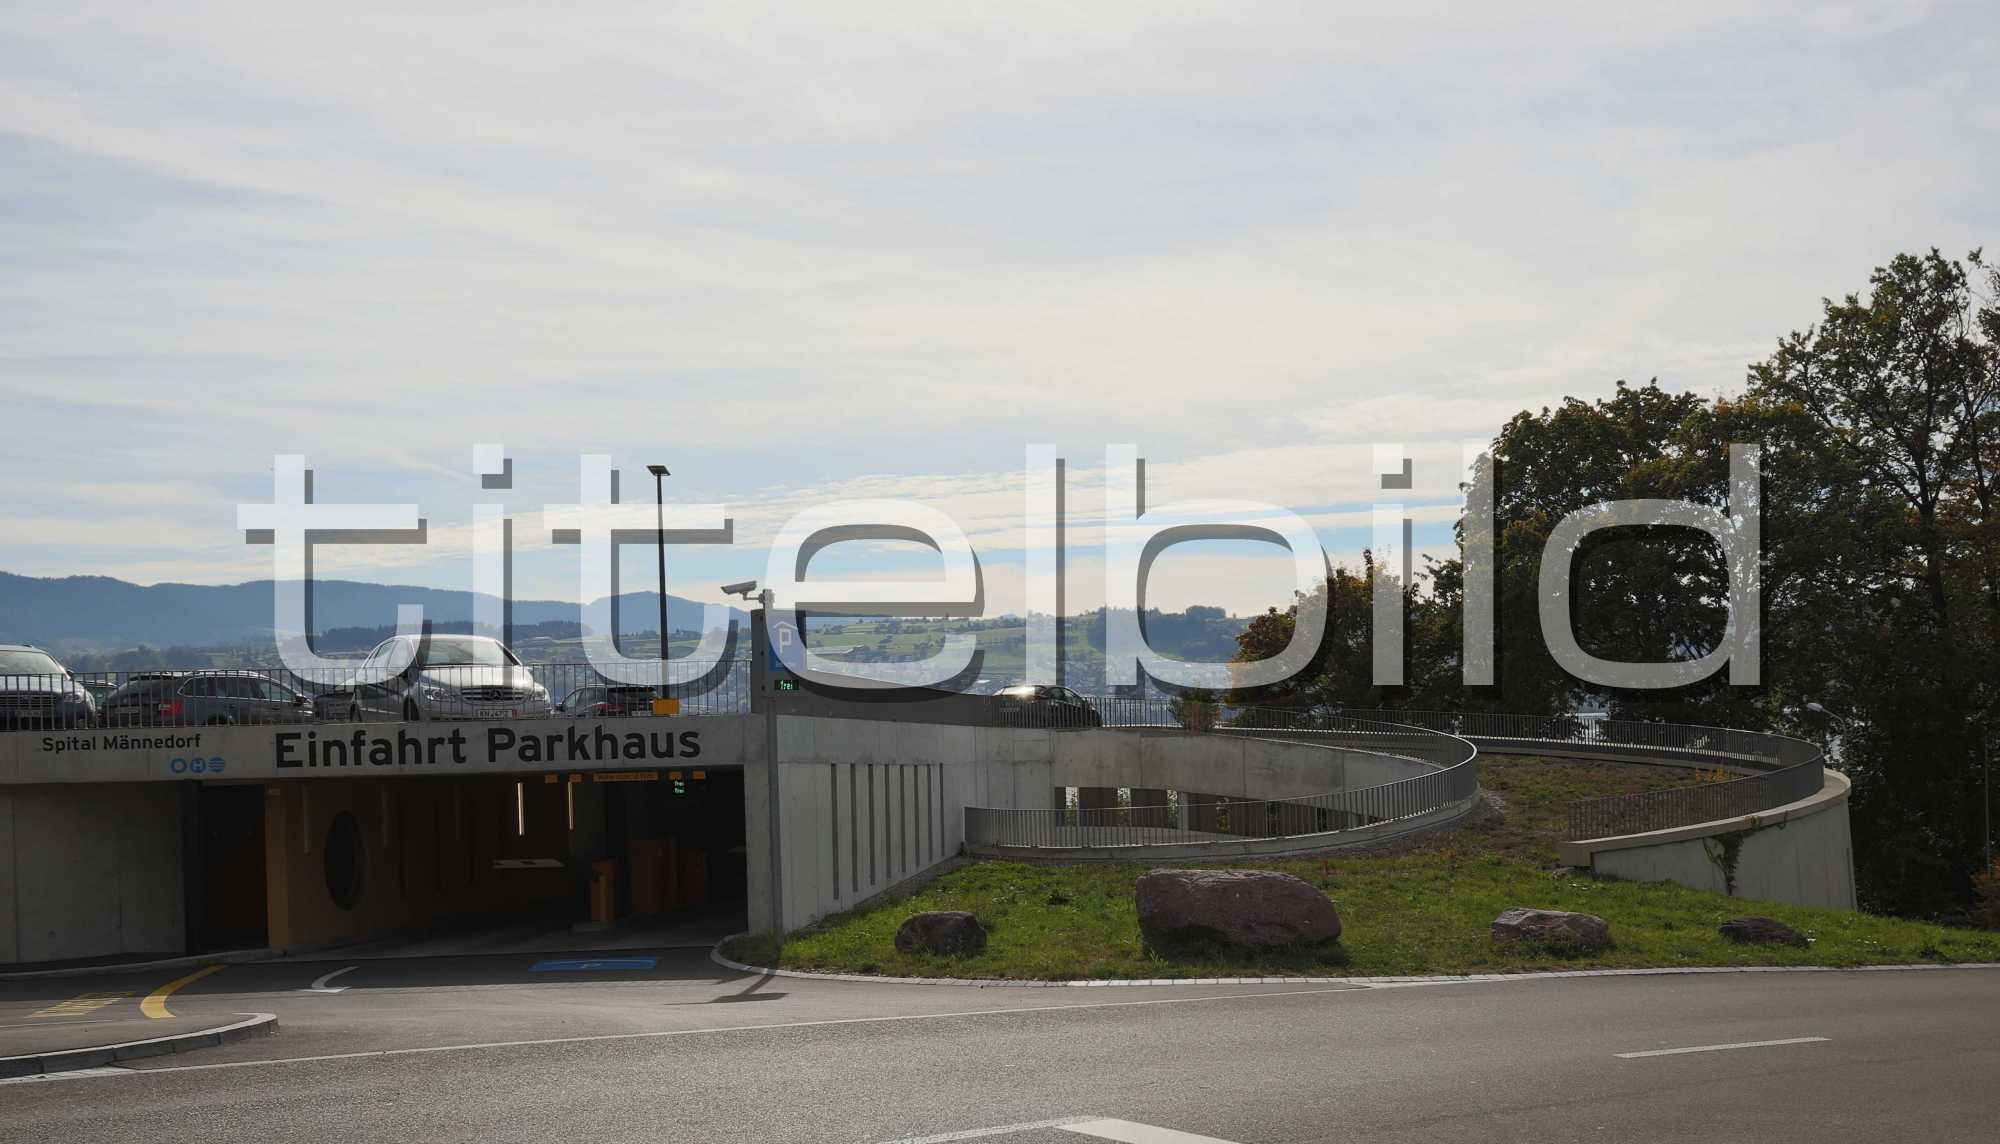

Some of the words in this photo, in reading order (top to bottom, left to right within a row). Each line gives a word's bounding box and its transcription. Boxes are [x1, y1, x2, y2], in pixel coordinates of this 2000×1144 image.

[779, 628, 792, 655] P
[42, 736, 96, 754] Spital
[103, 734, 201, 750] Männedorf
[275, 728, 467, 768] Einfahrt
[487, 725, 701, 763] Parkhaus
